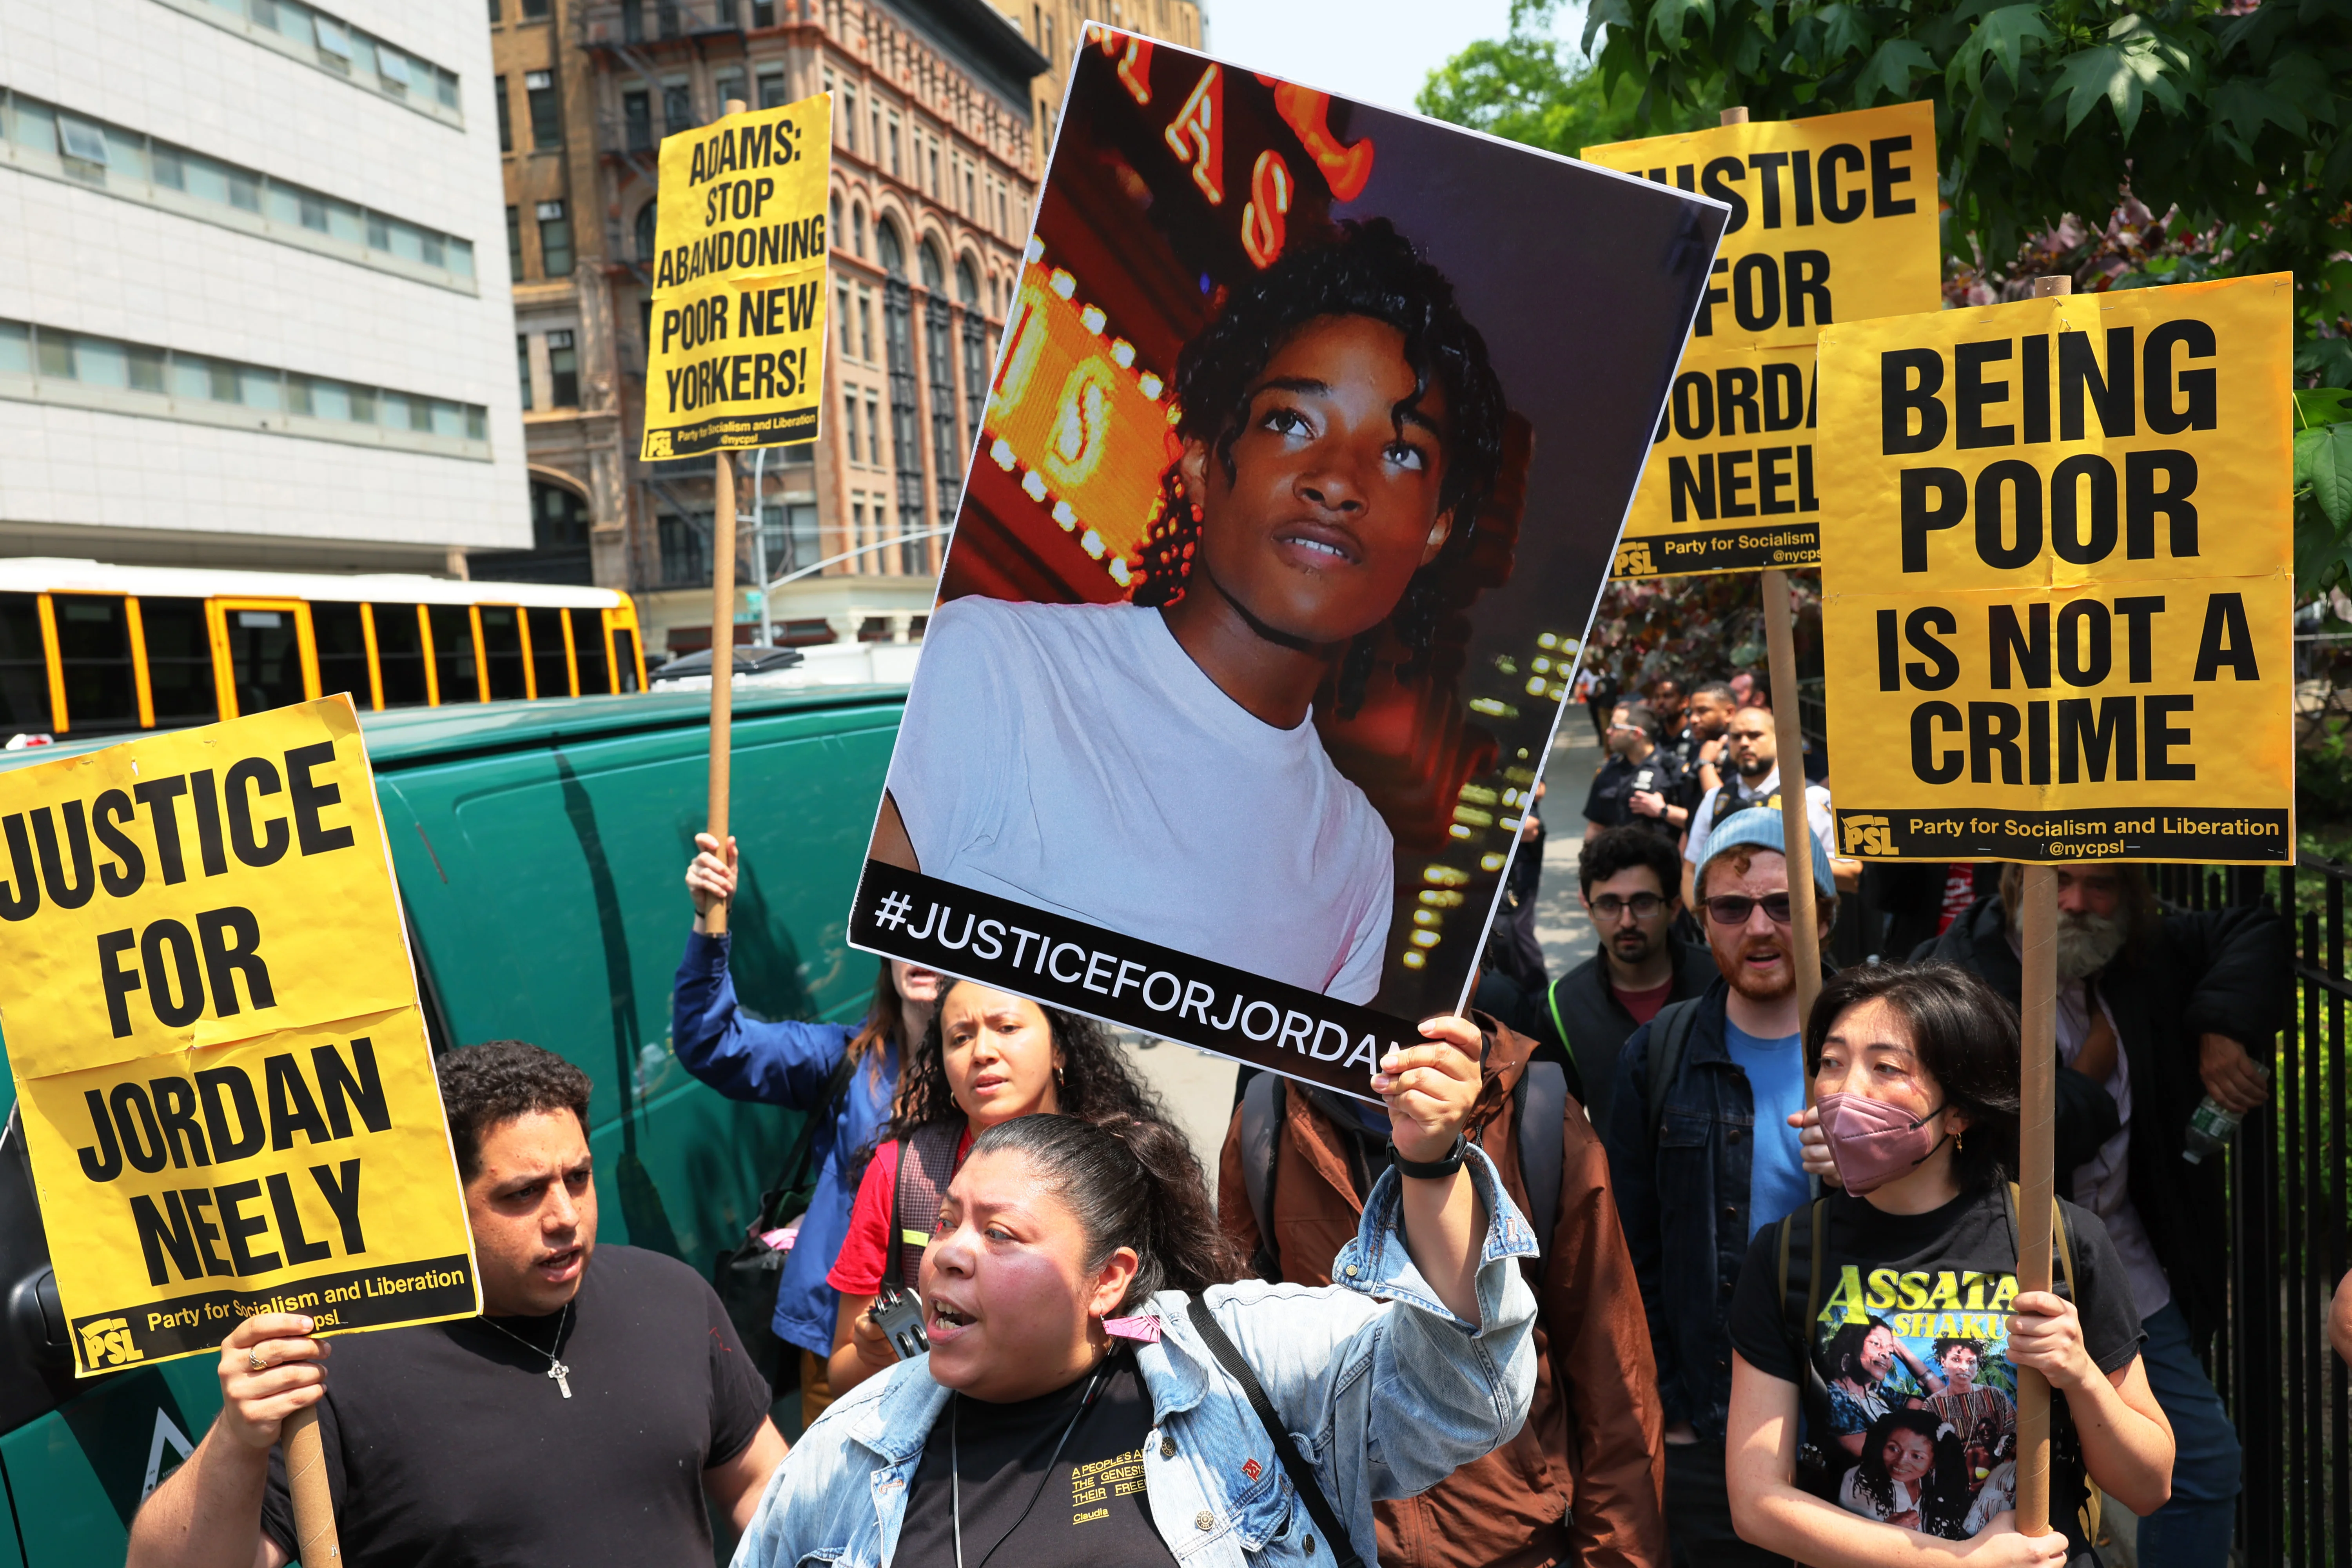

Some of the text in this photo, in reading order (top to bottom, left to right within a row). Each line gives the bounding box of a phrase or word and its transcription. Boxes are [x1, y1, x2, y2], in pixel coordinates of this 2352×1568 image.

[689, 119, 802, 187] ADAMS:
[705, 178, 774, 227] STOP
[1625, 135, 1916, 236] STICE
[657, 214, 825, 289] ABANDONING
[662, 280, 818, 354] POOR NEW
[666, 347, 807, 413] YORKERS!
[1880, 318, 2219, 456] BEING
[647, 437, 674, 457] PSL
[677, 429, 698, 442] Party
[708, 421, 751, 436] Socialism
[753, 419, 771, 431] and
[773, 414, 816, 429] Liberation
[720, 433, 759, 446] @nycpsl
[1899, 449, 2201, 574] POOR
[1613, 551, 1658, 576] PSL
[1664, 532, 1815, 555] Party for Socialism
[1876, 592, 2261, 693] IS NOT A
[1909, 694, 2196, 786] CRIME
[0, 740, 355, 922] JUSTICE
[1844, 827, 1899, 855] PSL
[1909, 817, 2279, 837] Party for Socialism and Liberation
[2049, 839, 2124, 857] @nycpsl
[96, 906, 278, 1039] FOR
[76, 1036, 392, 1183] JORDAN
[129, 1158, 367, 1287] NEELY
[147, 1269, 465, 1332] Party for Socialism and Liberation
[83, 1327, 144, 1369] PSL
[1072, 1468, 1081, 1477] A
[1082, 1452, 1132, 1474] PEOPLE'S
[1073, 1477, 1094, 1490] THE
[1242, 1461, 1260, 1482] PSL
[1073, 1487, 1106, 1504] THEIR
[1073, 1508, 1108, 1523] Claudia
